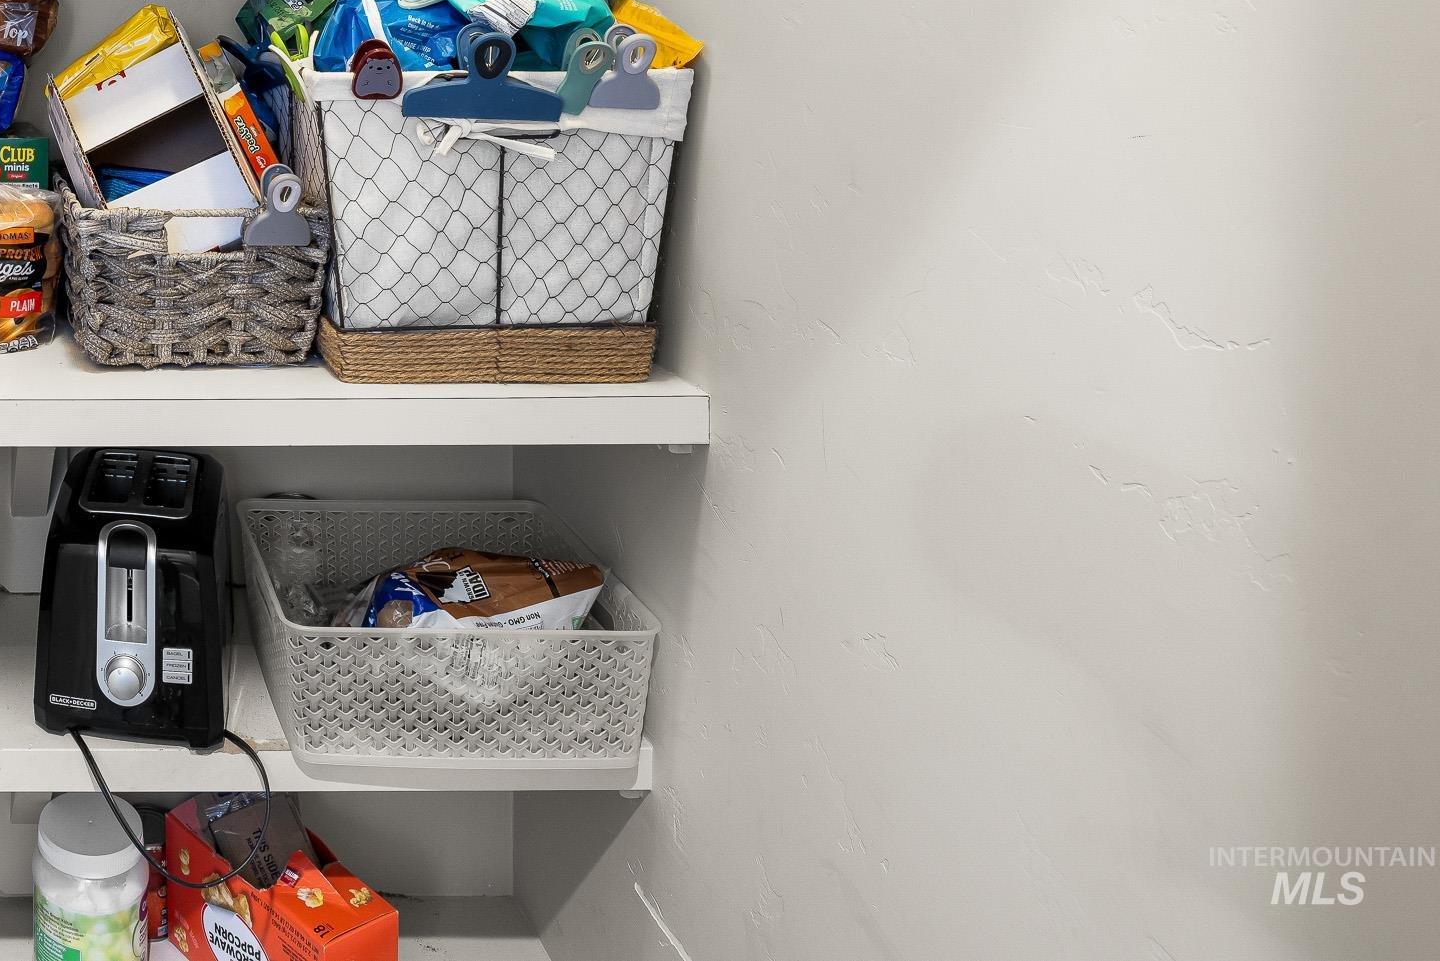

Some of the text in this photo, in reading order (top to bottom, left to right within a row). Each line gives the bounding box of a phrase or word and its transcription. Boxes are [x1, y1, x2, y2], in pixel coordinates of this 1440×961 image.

[3, 20, 28, 46] Top
[0, 145, 35, 164] CLUB
[4, 163, 30, 171] minis
[10, 298, 35, 312] PLAIN
[508, 611, 540, 627] Non GMO
[264, 854, 280, 879] SIDE
[214, 922, 261, 958] POPCORN
[314, 924, 329, 939] 18
